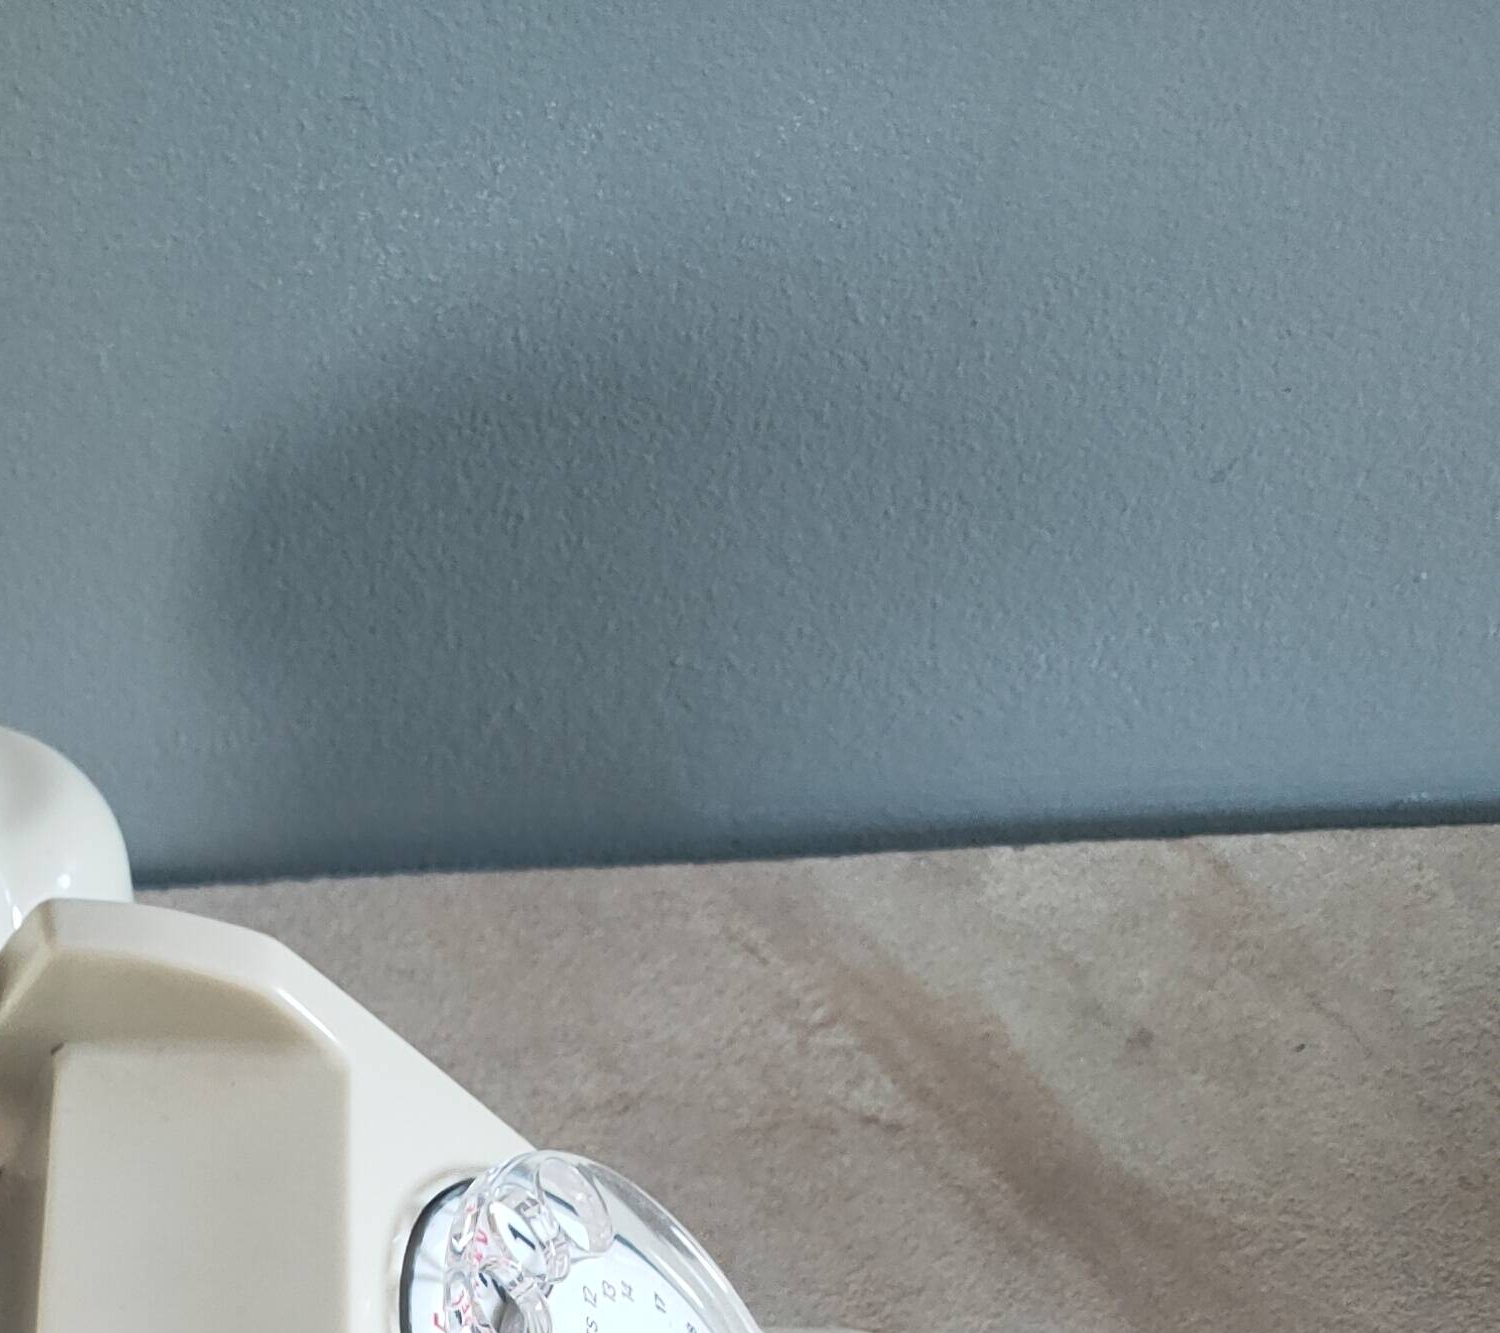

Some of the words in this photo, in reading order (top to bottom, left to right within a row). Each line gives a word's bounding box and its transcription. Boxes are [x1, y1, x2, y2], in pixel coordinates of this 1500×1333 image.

[583, 1286, 597, 1308] 12
[602, 1280, 617, 1302] 13
[621, 1281, 635, 1303] 14
